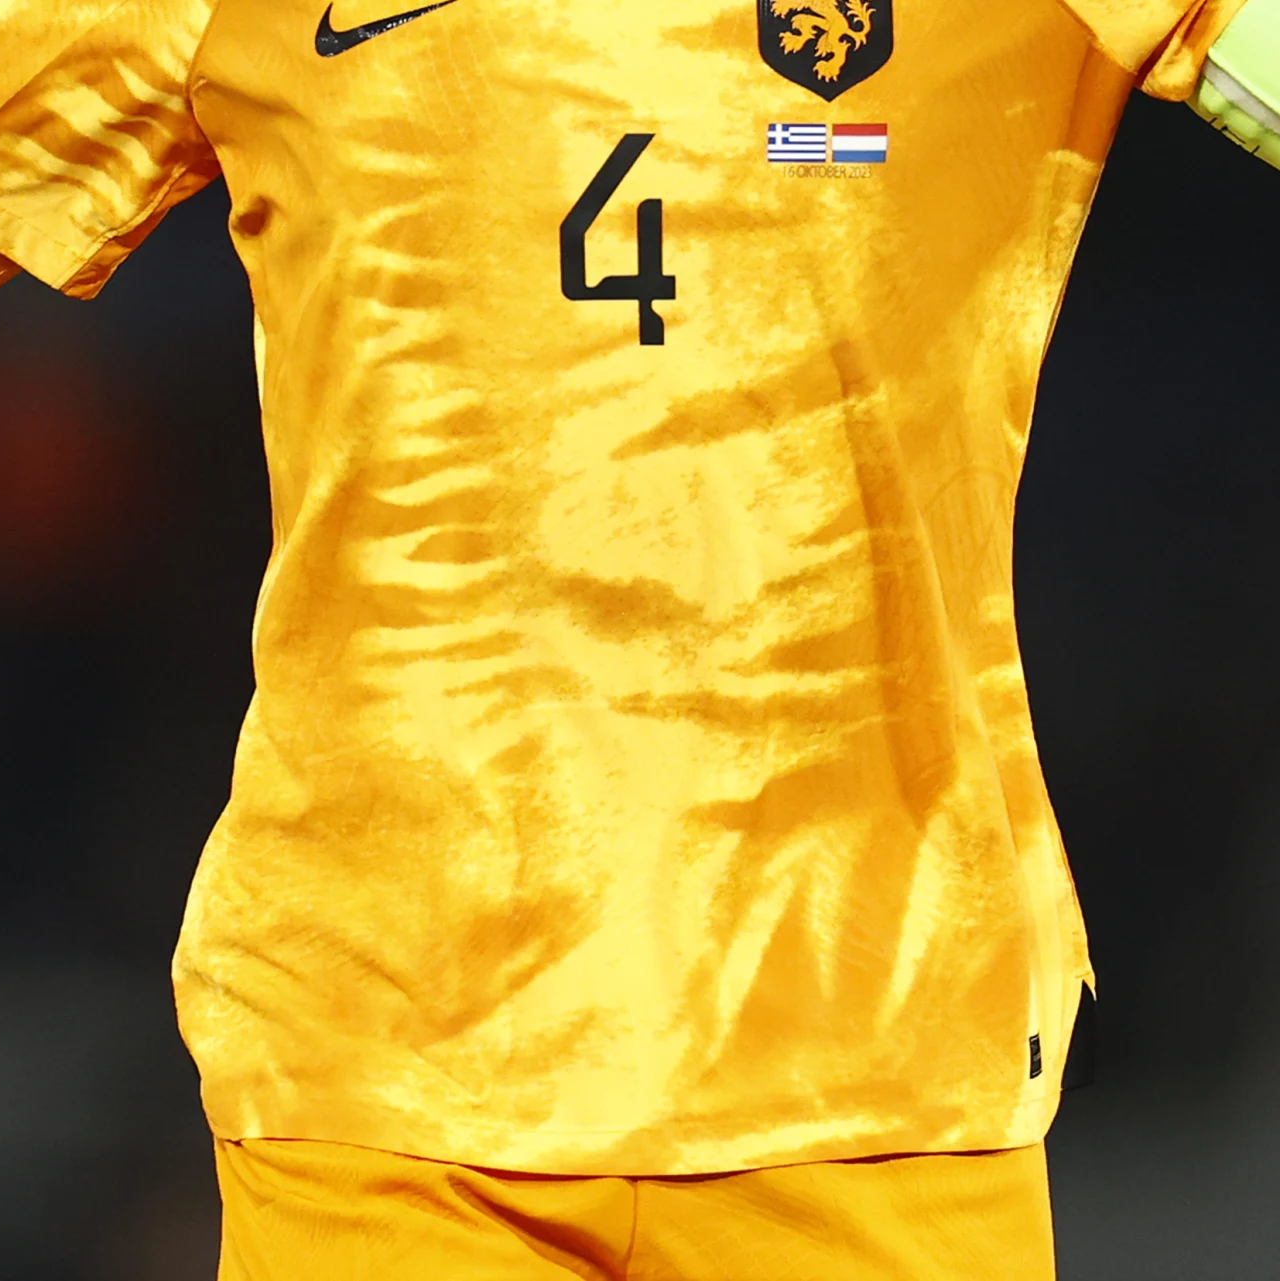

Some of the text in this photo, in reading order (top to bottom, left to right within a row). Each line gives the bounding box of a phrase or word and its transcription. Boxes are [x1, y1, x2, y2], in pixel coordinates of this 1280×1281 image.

[796, 165, 847, 178] OKTOBER
[848, 165, 873, 178] 2023
[560, 133, 676, 345] 4
